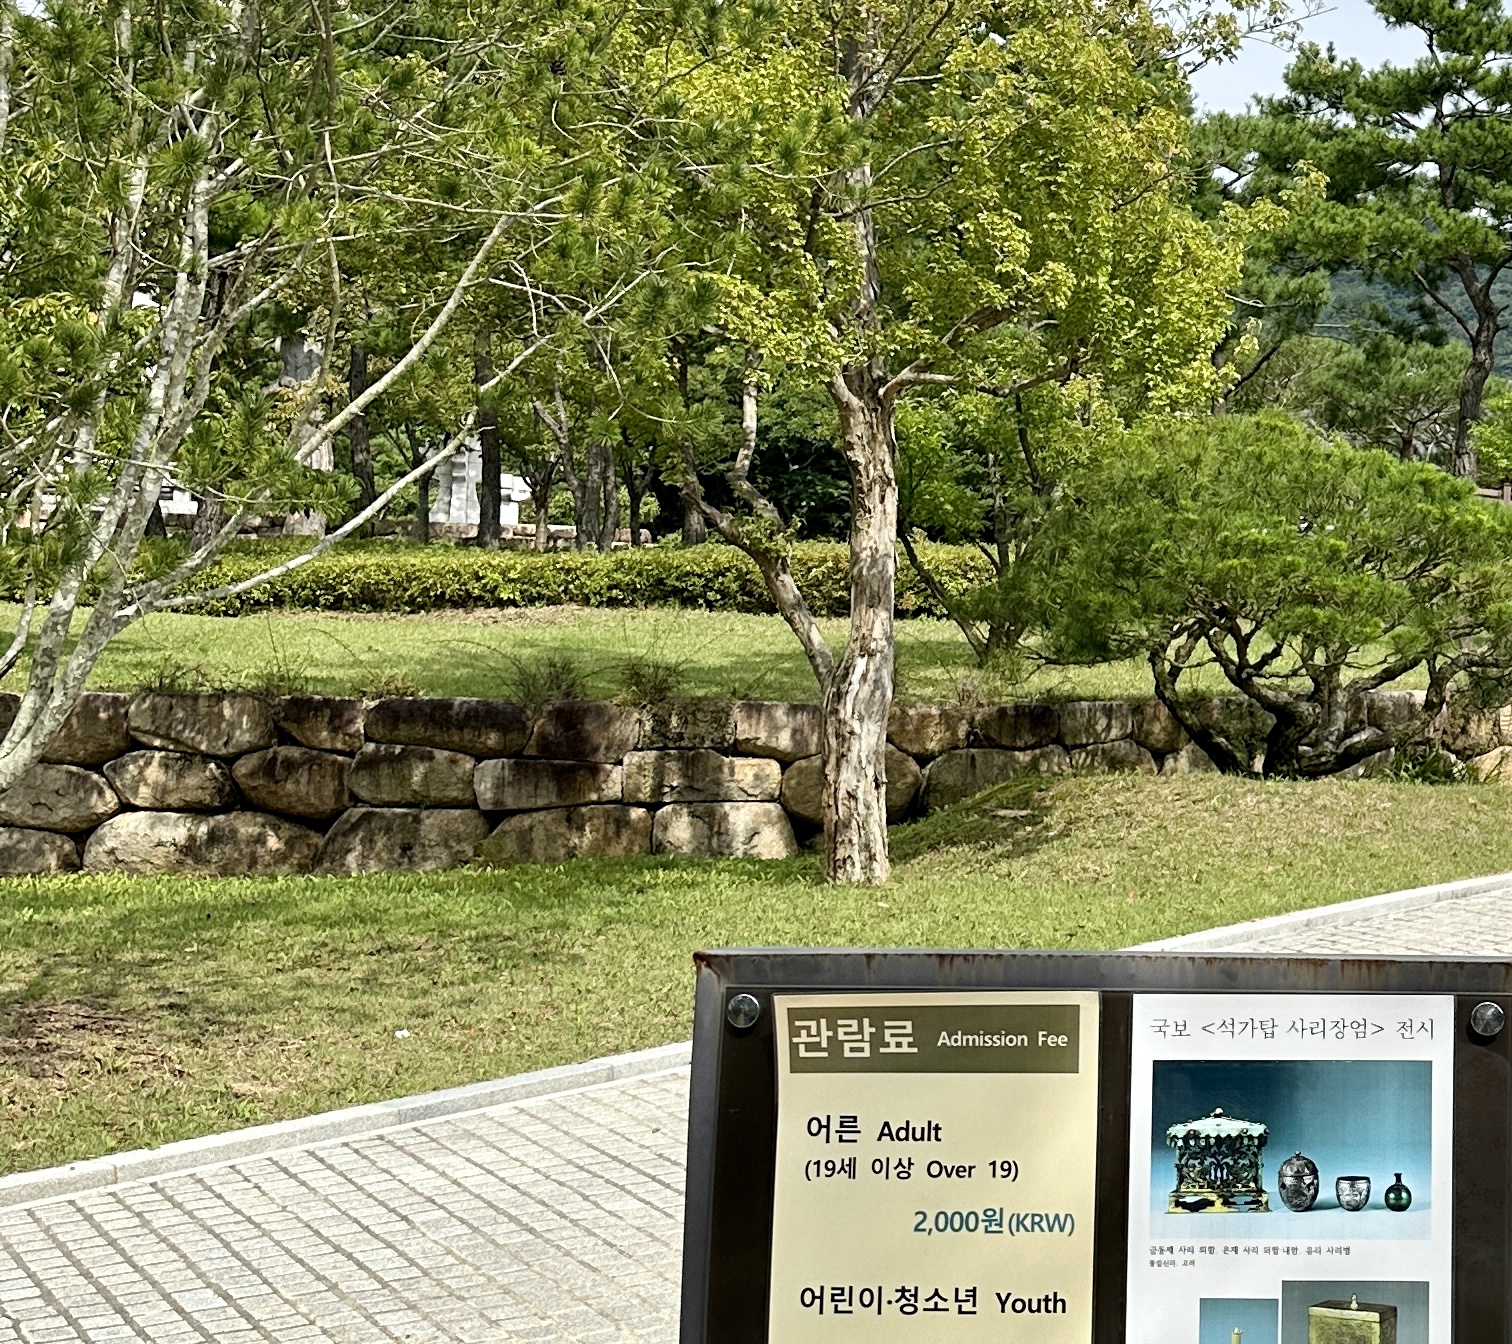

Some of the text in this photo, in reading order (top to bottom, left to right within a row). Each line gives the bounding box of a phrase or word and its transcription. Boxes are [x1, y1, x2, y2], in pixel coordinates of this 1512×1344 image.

[790, 1017, 1068, 1060] 관람료 Admission Fee
[1151, 1018, 1433, 1040] 국보 <석가탑 사리장엄> 전시
[807, 1115, 942, 1143] 어른 Adult
[805, 1157, 1018, 1182] (19세 이상 Over 19)
[914, 1208, 1074, 1236] 2,000원(KRW)
[801, 1286, 1066, 1315] 어린이·청소년 Youth
